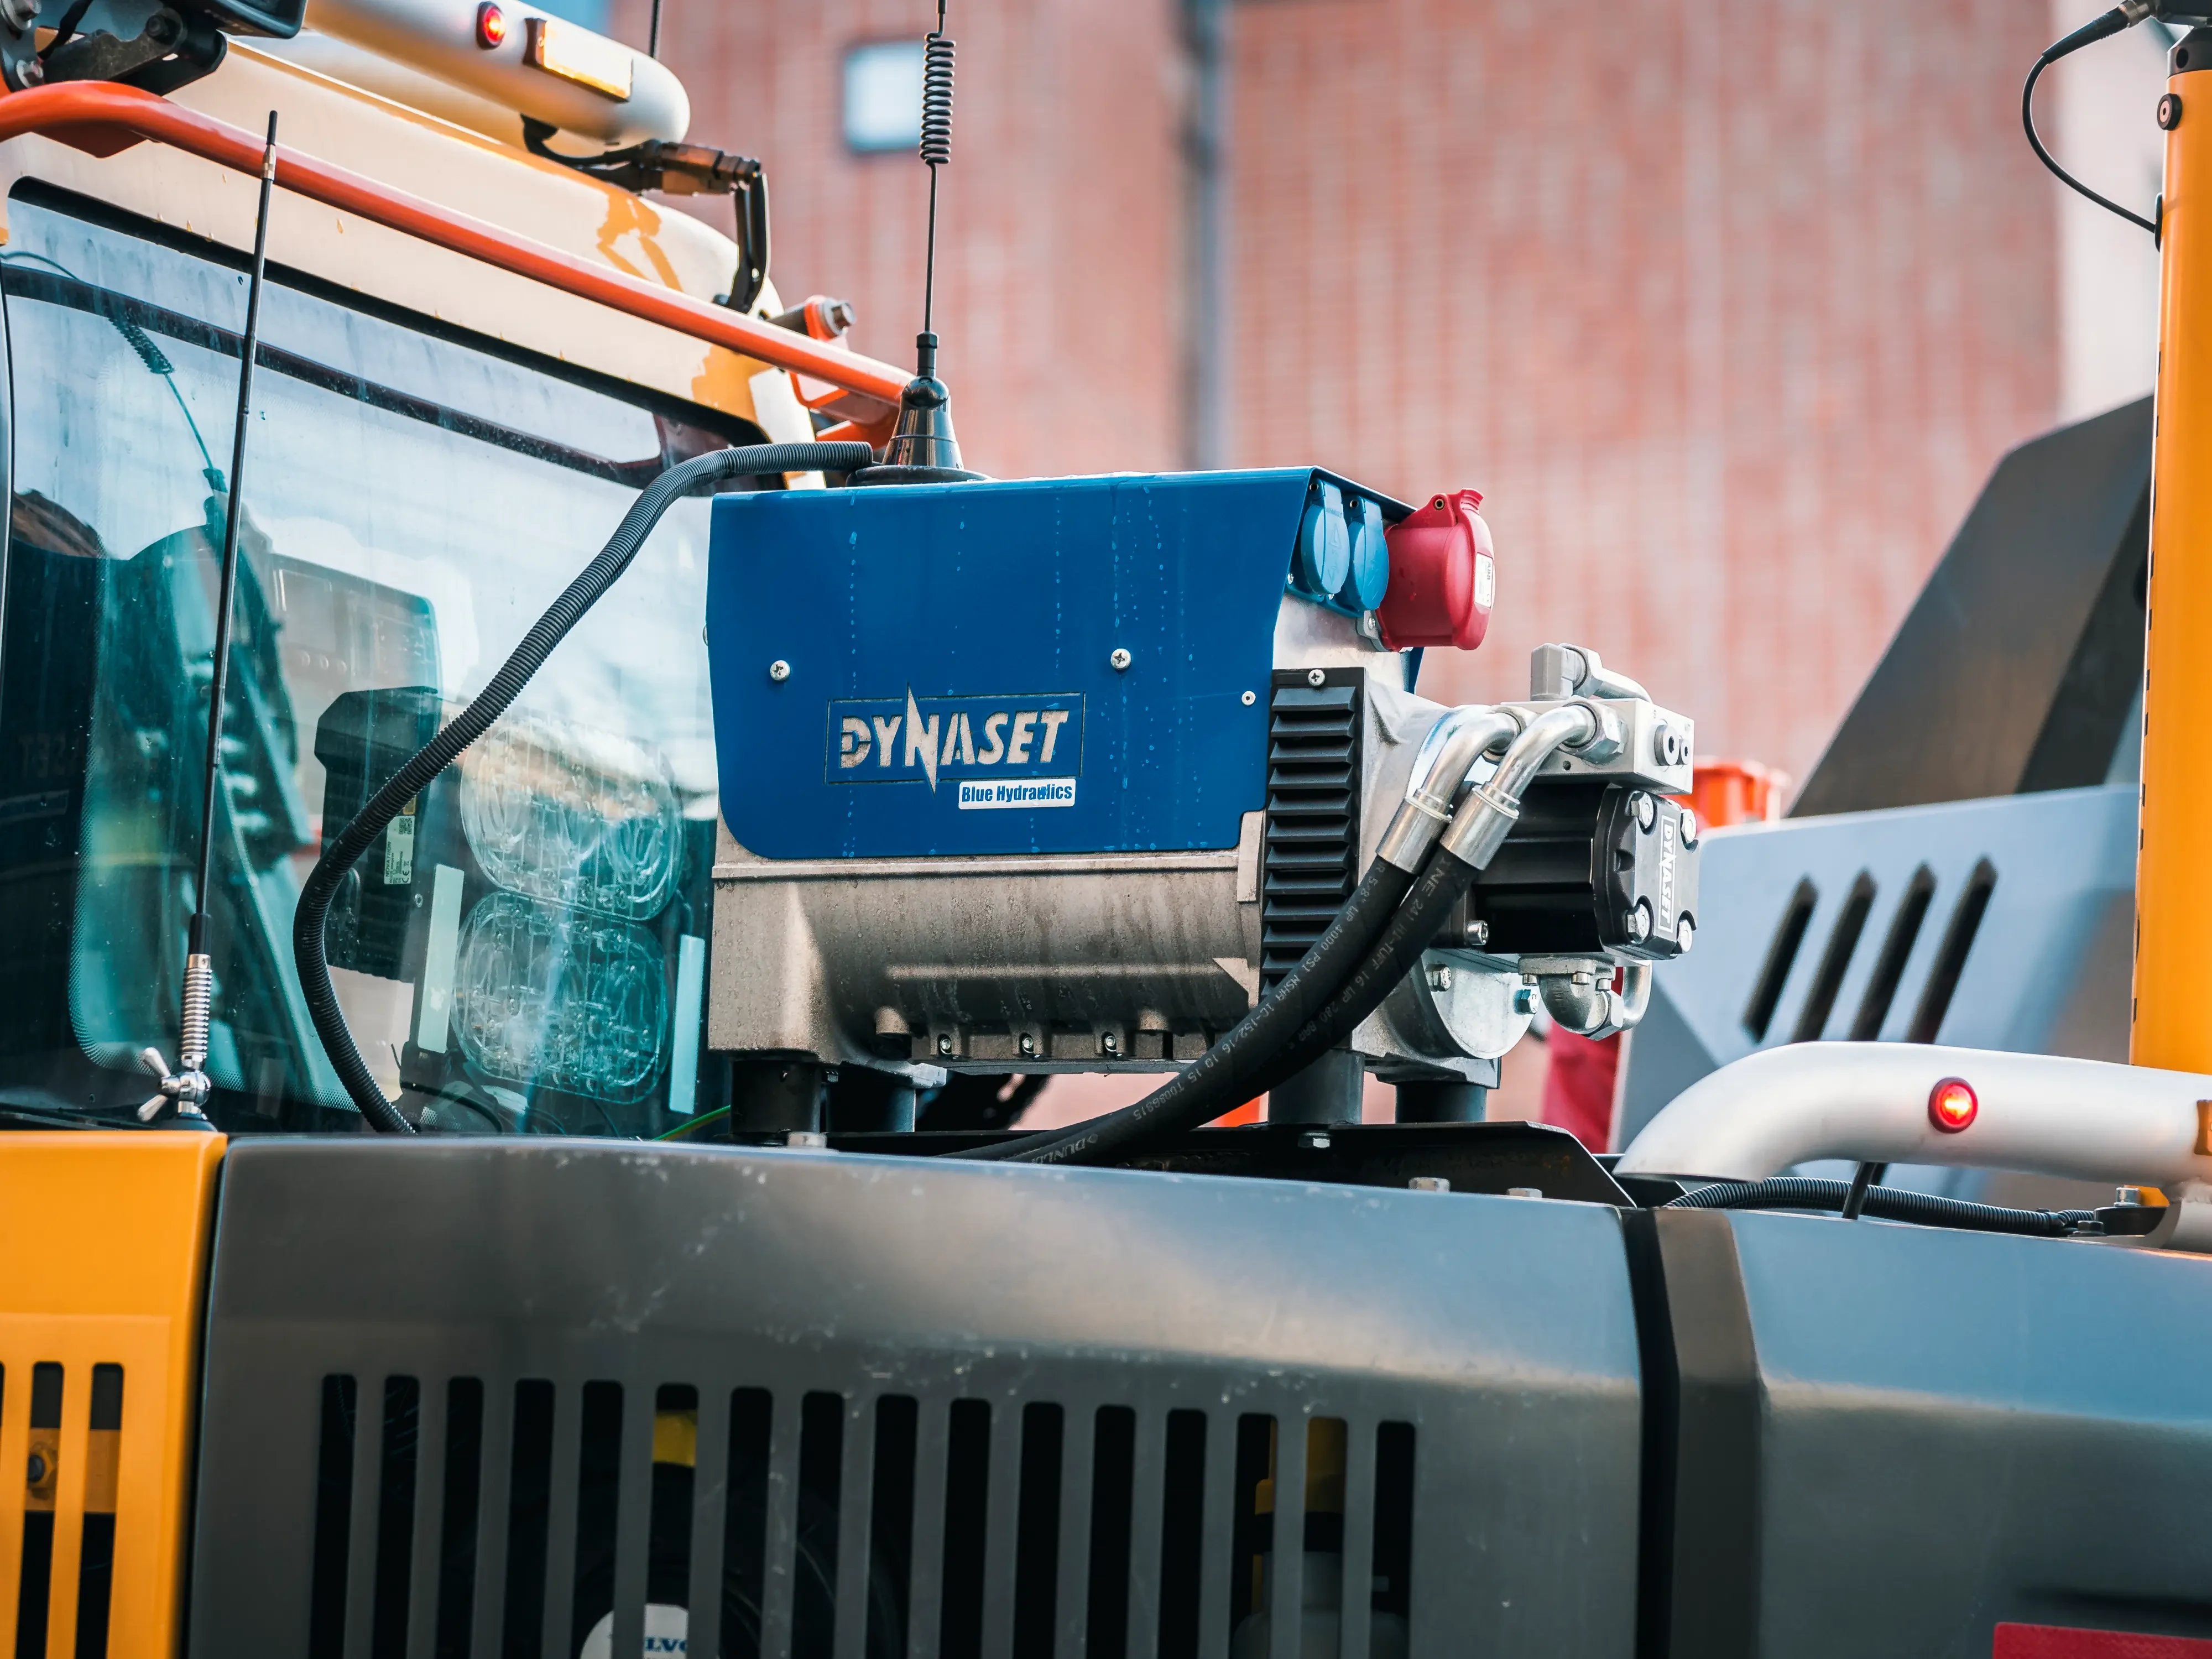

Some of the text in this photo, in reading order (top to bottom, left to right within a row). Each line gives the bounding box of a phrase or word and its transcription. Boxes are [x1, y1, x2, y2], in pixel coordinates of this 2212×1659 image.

[839, 682, 1069, 797] DYNASET
[962, 784, 1072, 802] Blue Hydraulics
[1659, 824, 1677, 924] DYNASET
[1346, 906, 1359, 922] WP
[1321, 924, 1343, 951] 4000
[1301, 952, 1321, 973] PSI
[1275, 974, 1301, 1001] MSHA
[1355, 971, 1370, 987] 16
[1188, 1068, 1202, 1083] 15
